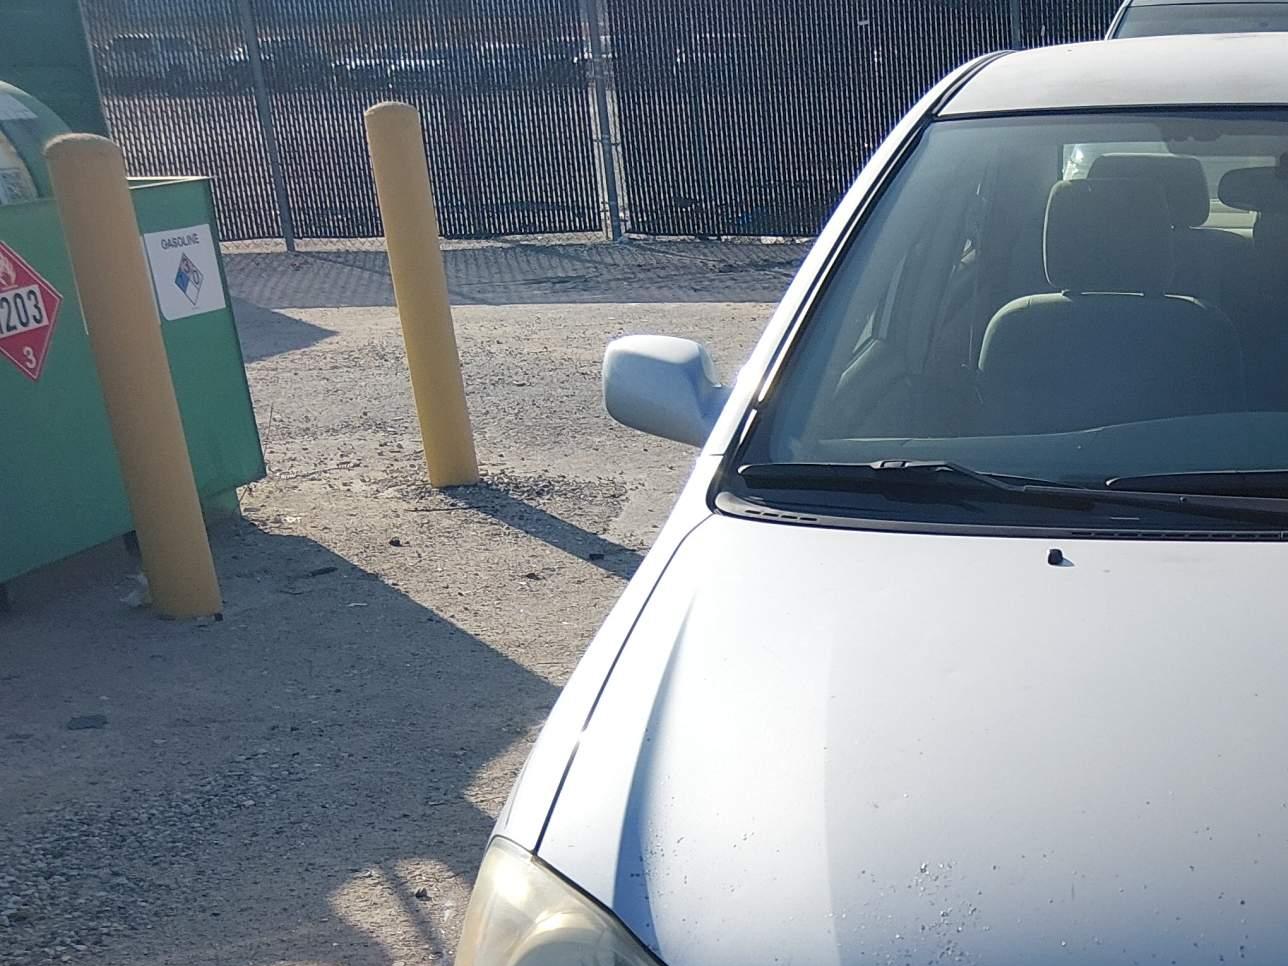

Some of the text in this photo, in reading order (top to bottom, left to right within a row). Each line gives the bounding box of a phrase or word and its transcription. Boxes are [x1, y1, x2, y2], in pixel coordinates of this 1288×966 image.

[161, 233, 200, 250] GASOLINE
[193, 270, 200, 285] 0
[23, 346, 37, 369] 3
